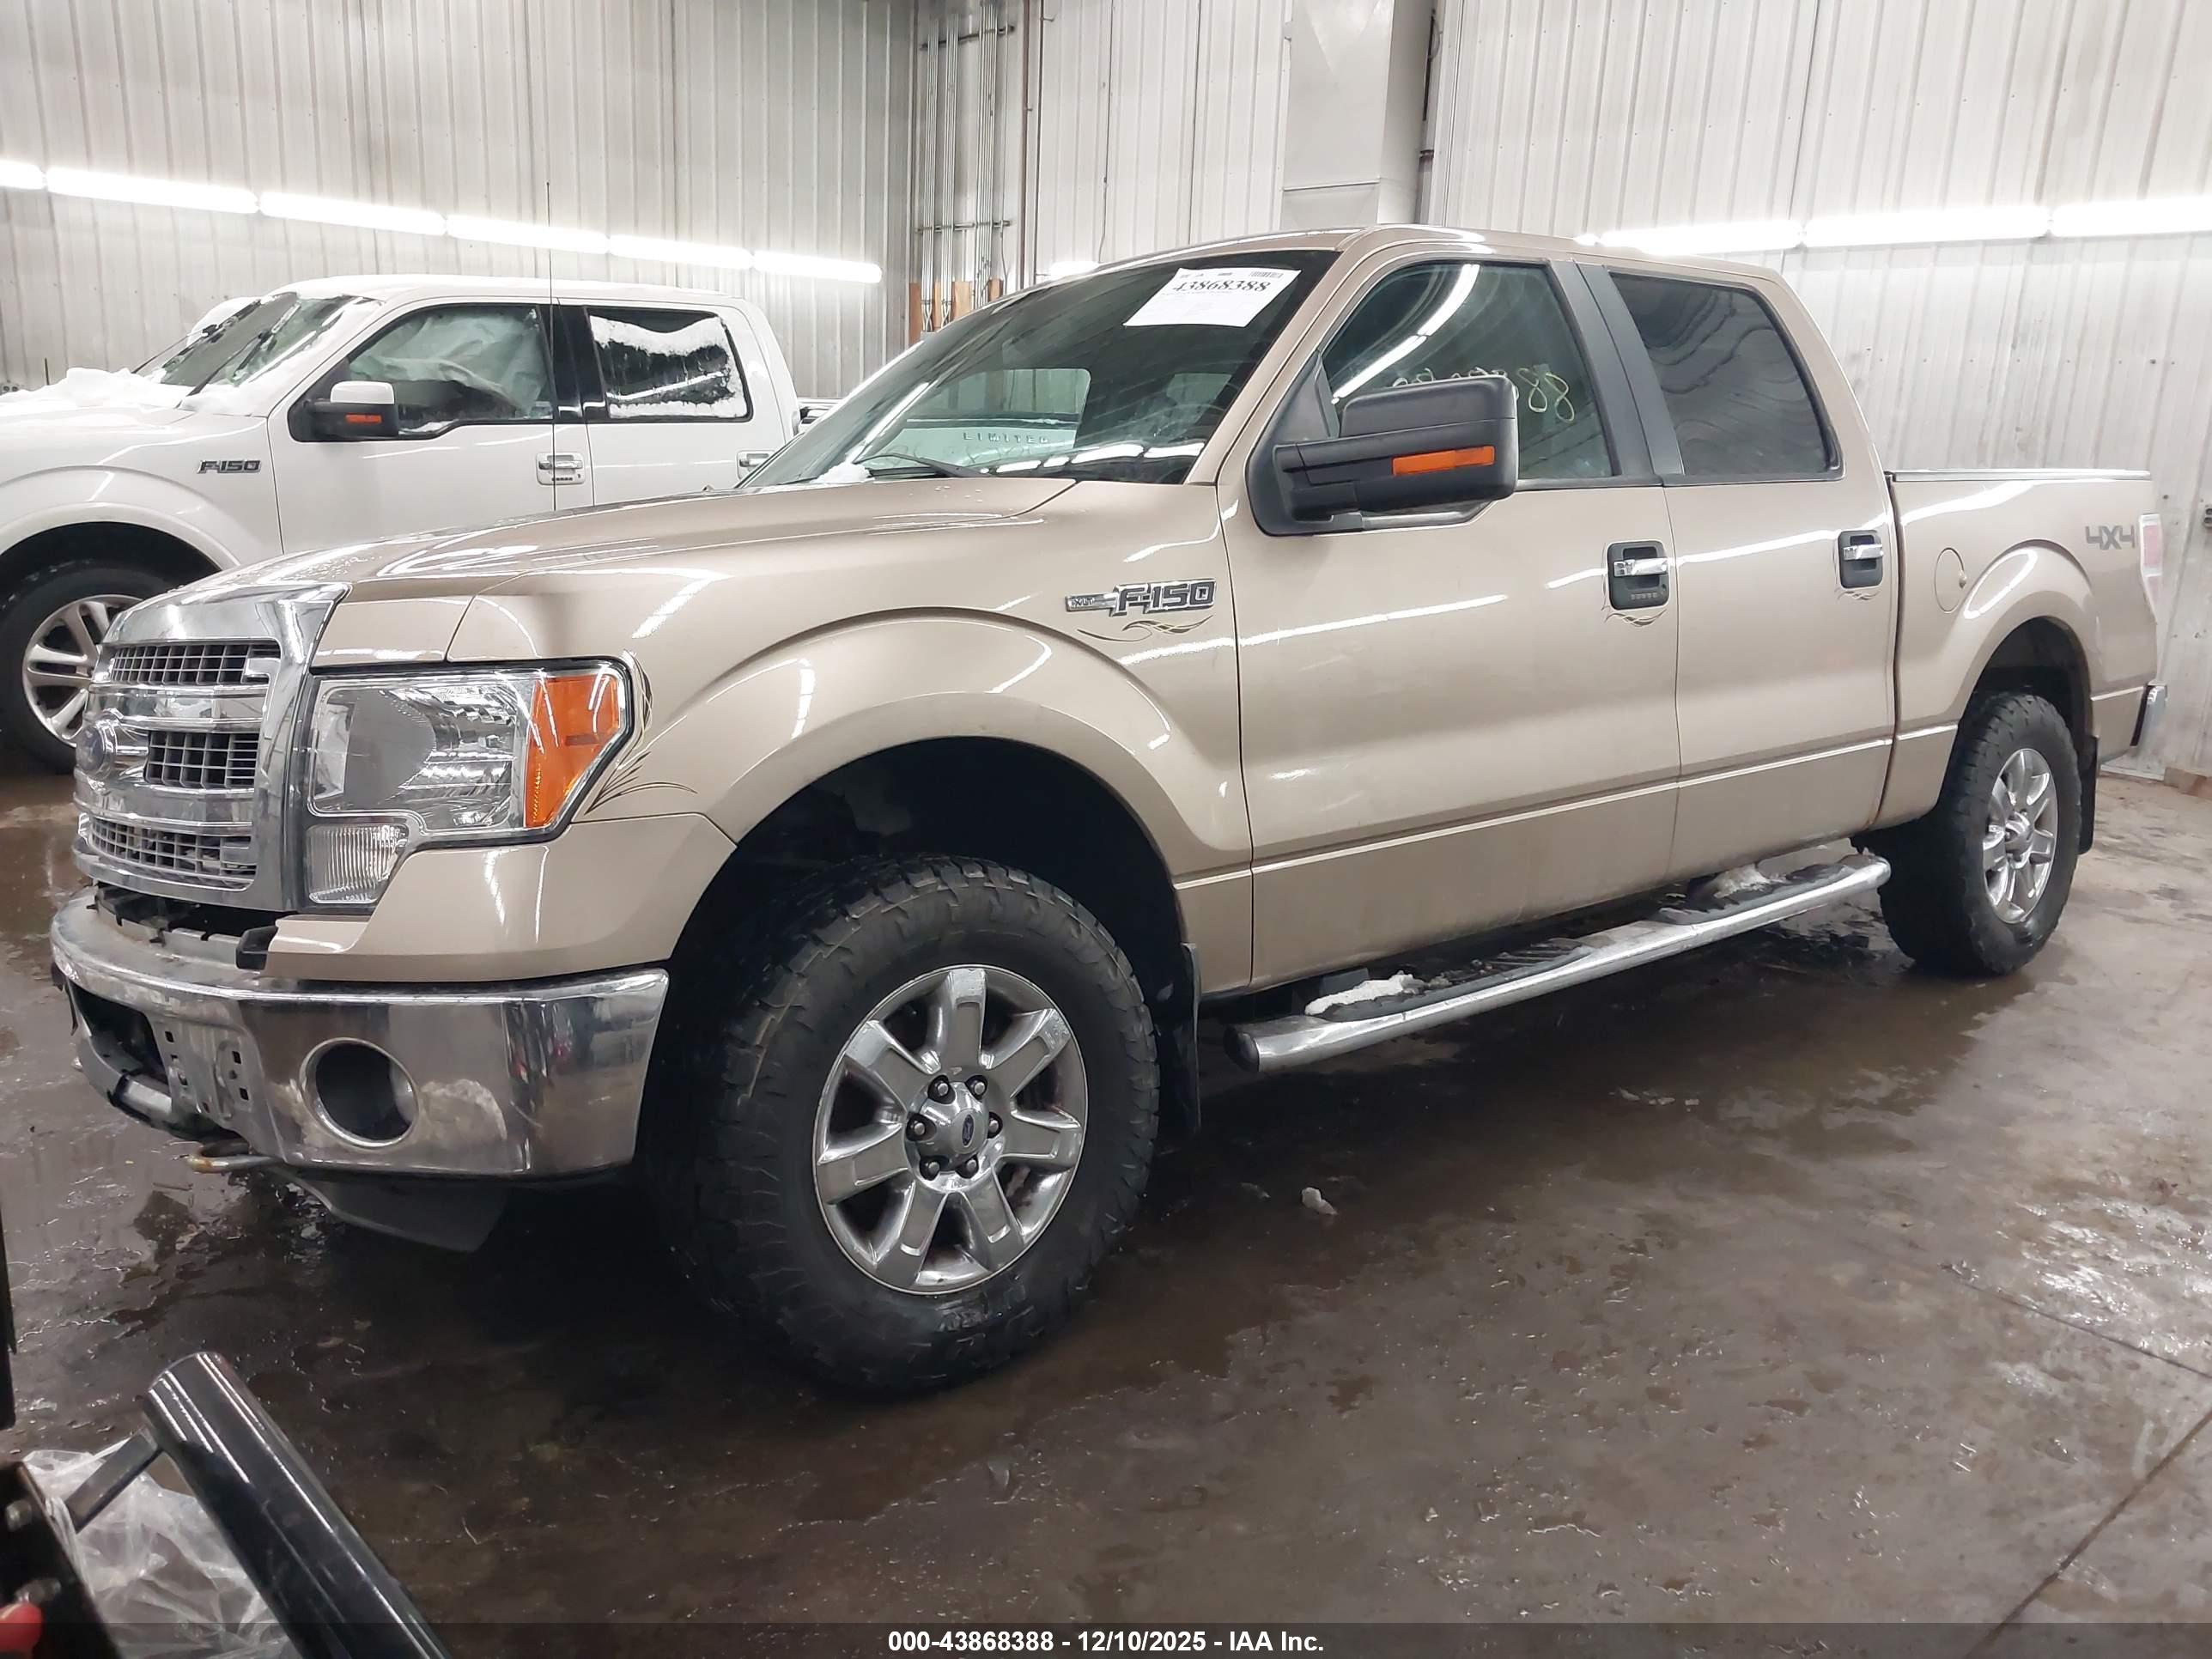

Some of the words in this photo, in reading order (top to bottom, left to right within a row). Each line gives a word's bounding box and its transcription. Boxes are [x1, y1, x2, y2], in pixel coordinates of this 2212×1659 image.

[1173, 280, 1271, 292] 43868388
[963, 432, 1049, 444] LIMITED
[198, 459, 261, 474] F-150
[1113, 579, 1216, 617] F-150
